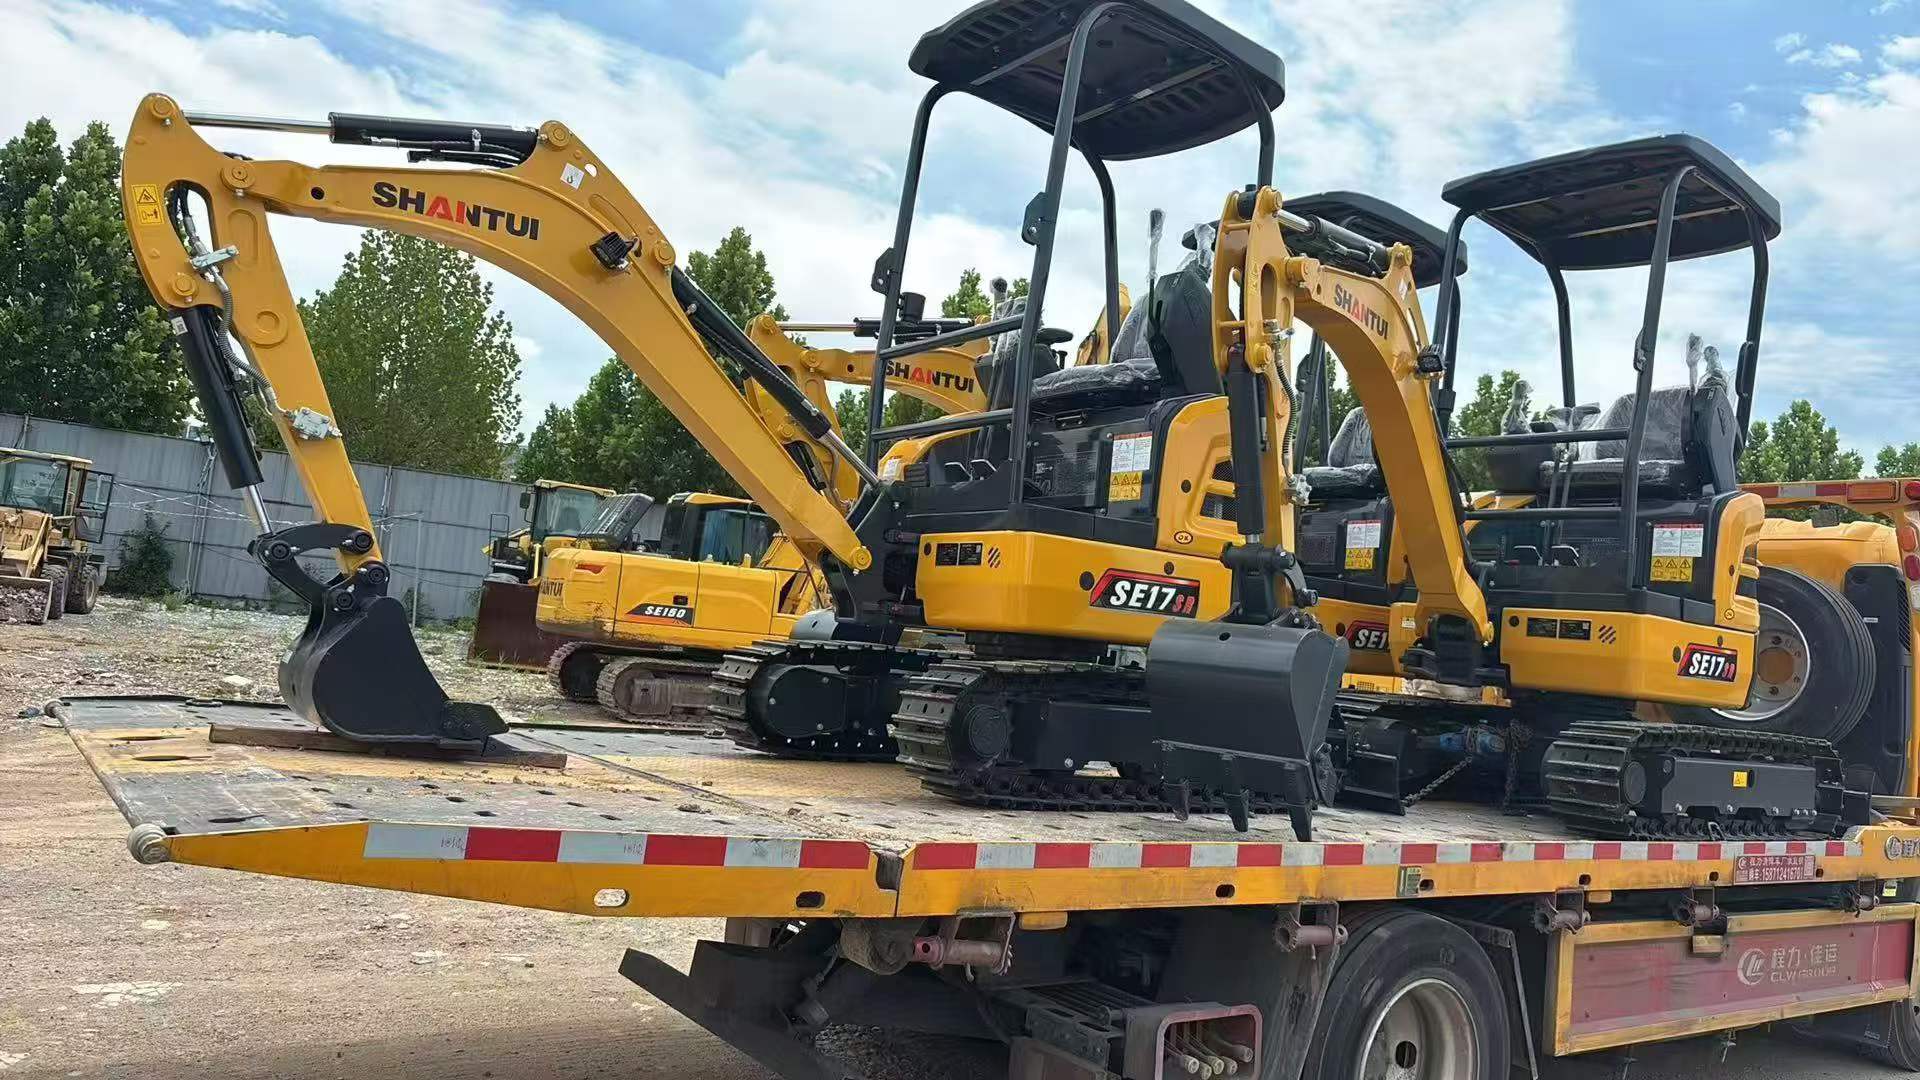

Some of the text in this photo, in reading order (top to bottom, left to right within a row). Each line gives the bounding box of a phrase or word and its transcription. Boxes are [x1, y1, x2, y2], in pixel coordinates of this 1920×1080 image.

[372, 181, 540, 240] SHANTUI
[1334, 283, 1389, 341] SHANTUI
[885, 360, 975, 393] SHANTUI
